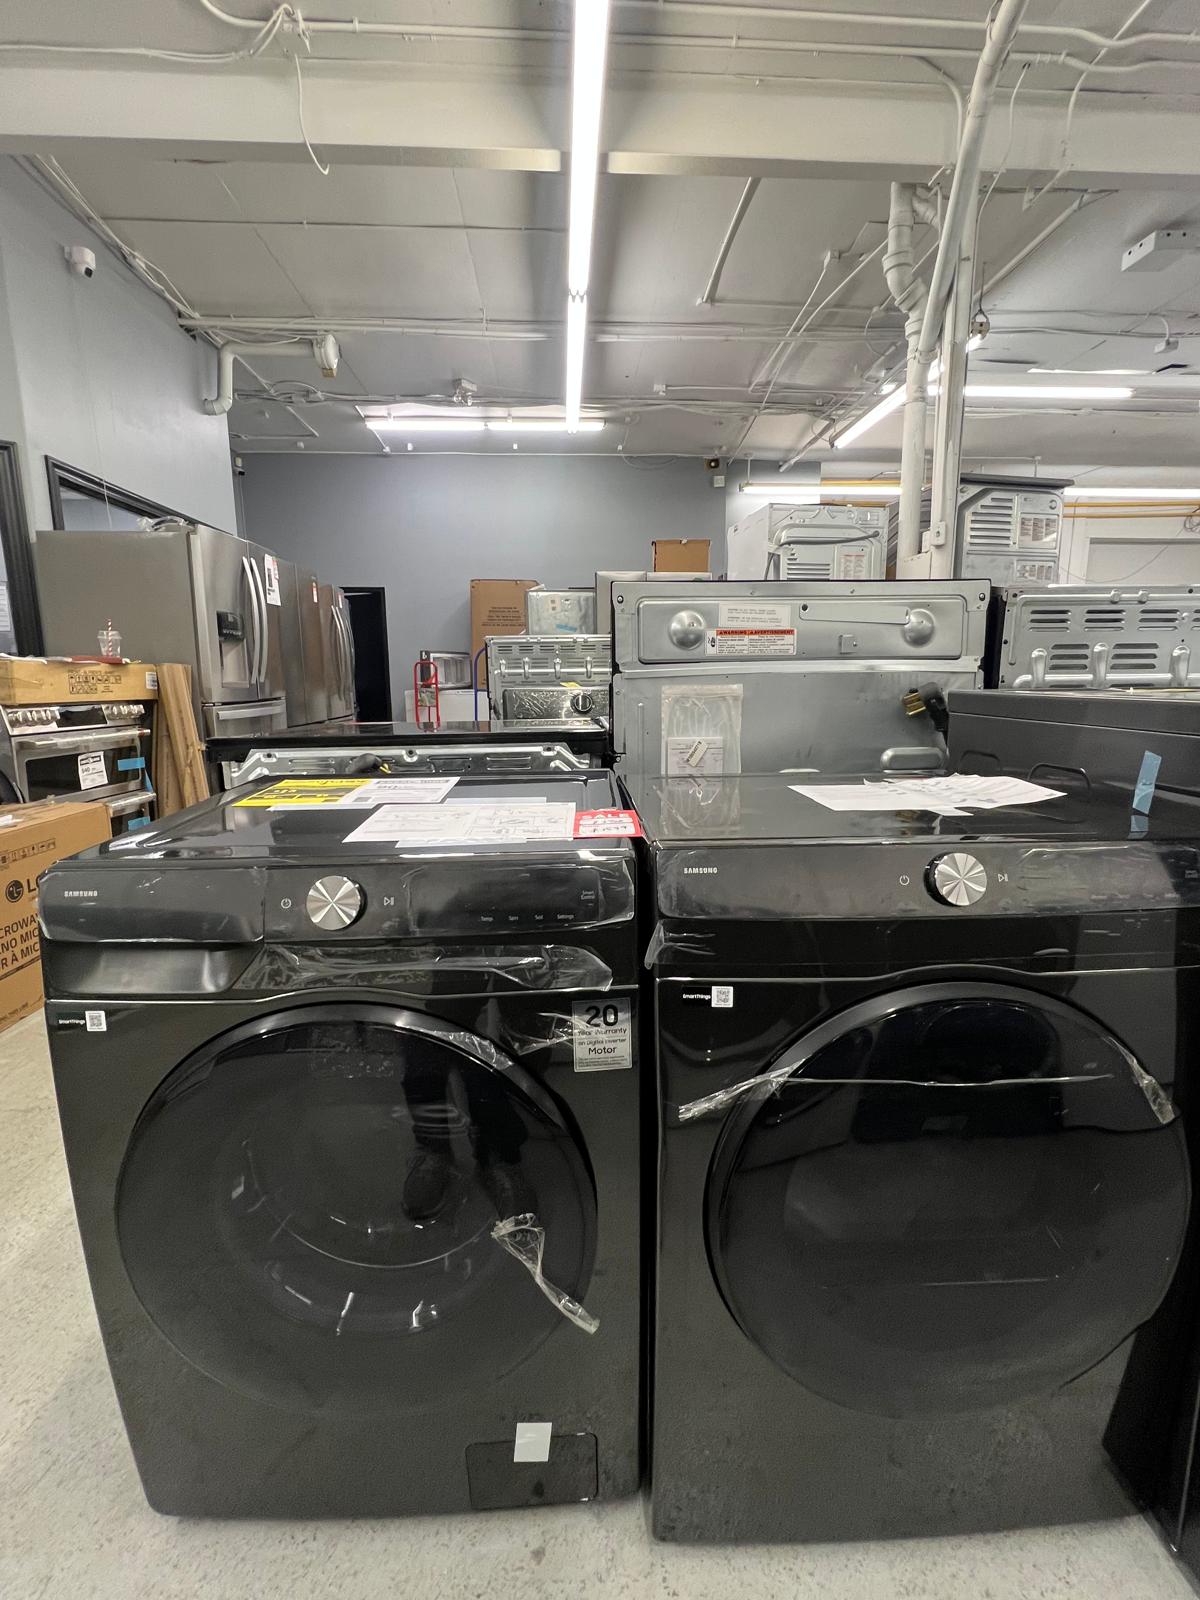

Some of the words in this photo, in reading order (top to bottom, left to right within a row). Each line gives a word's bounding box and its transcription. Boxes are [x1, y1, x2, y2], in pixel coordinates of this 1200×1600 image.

[585, 1004, 619, 1027] 20
[594, 1027, 627, 1036] Warranty
[588, 1046, 617, 1055] Motor
